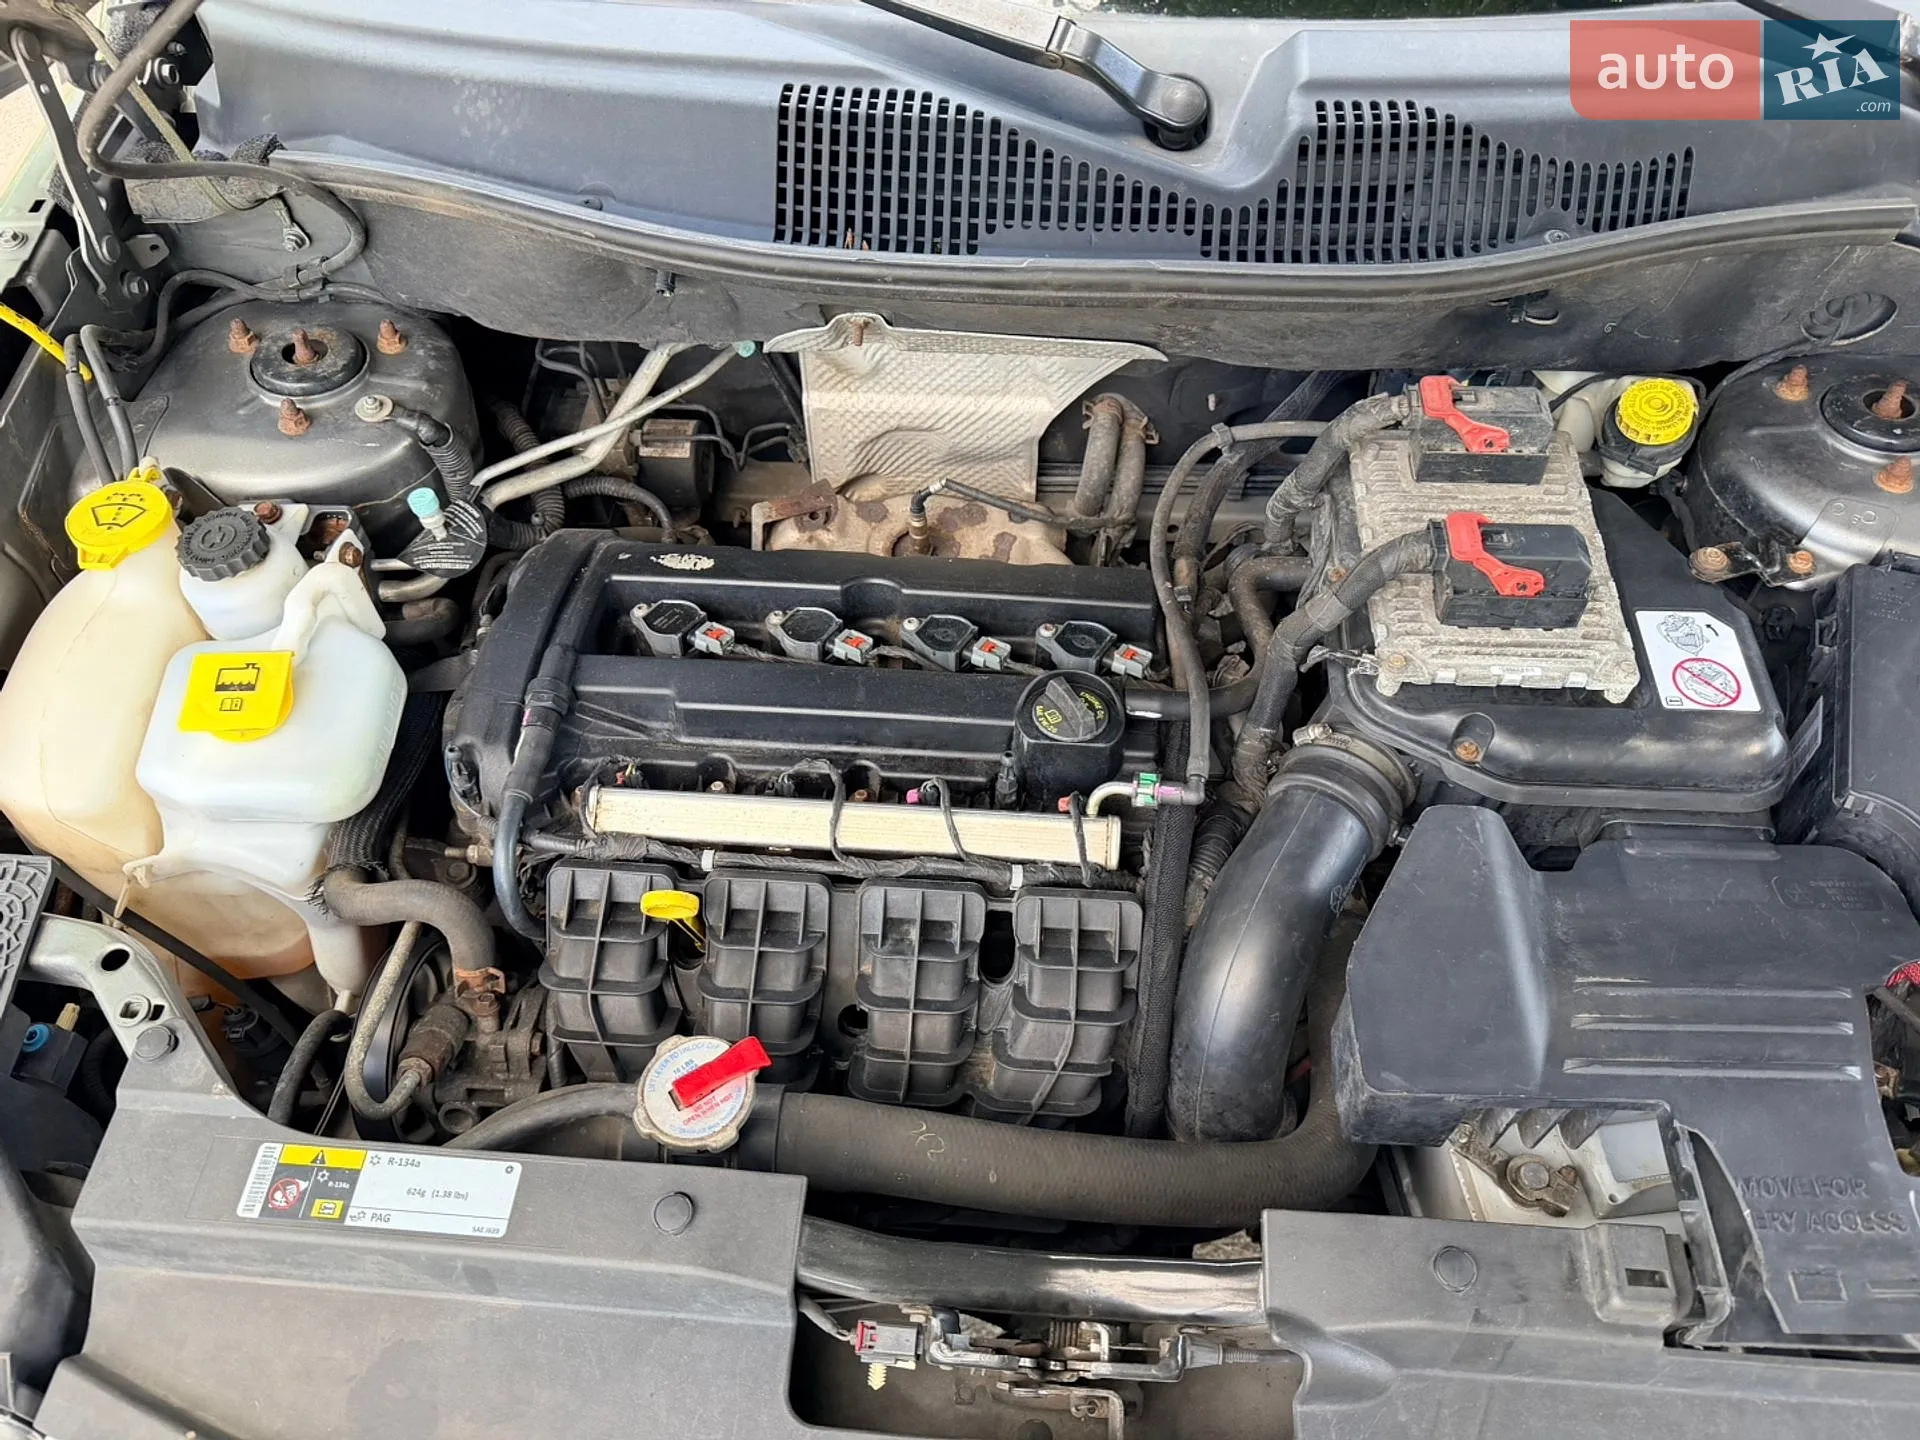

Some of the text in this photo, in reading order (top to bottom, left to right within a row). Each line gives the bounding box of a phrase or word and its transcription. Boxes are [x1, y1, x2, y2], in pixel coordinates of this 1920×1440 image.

[682, 1111, 701, 1126] OPEN
[387, 1157, 421, 1168] R-134a
[406, 1187, 427, 1198] 624g
[1811, 1175, 1869, 1200] FOR
[370, 1212, 391, 1223] PAG
[1806, 1208, 1911, 1235] ACCESS
